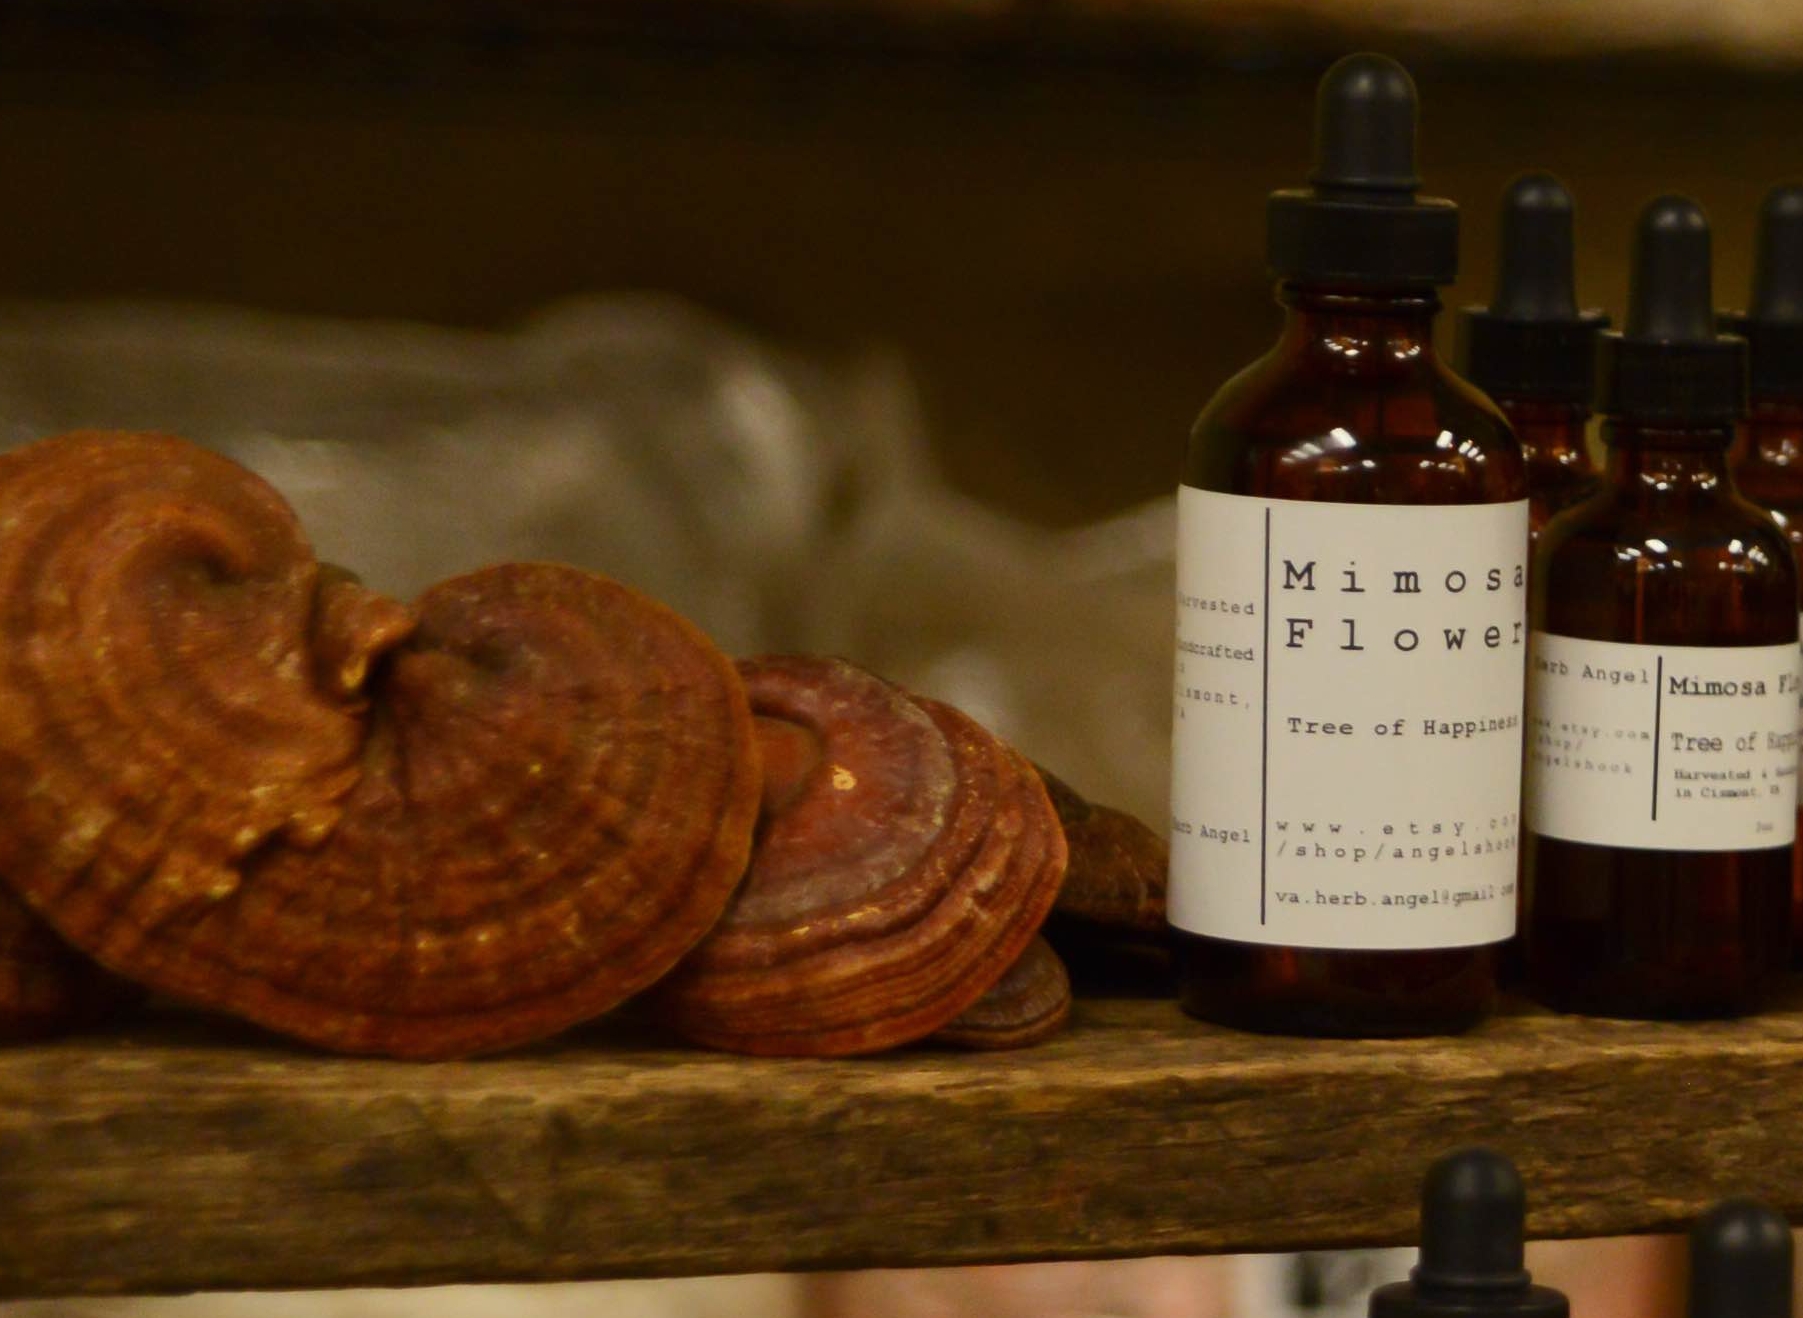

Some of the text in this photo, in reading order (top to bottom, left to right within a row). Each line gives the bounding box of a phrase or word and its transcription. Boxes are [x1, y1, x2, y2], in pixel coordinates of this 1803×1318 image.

[1283, 560, 1524, 592] Mimosa
[1286, 616, 1522, 651] Flower
[1581, 663, 1650, 685] Angel
[1669, 676, 1767, 696] Mimosa
[1288, 717, 1354, 735] Tree
[1374, 718, 1405, 737] of
[1671, 732, 1723, 752] Tree
[1735, 732, 1758, 751] of
[1199, 823, 1251, 844] Angel
